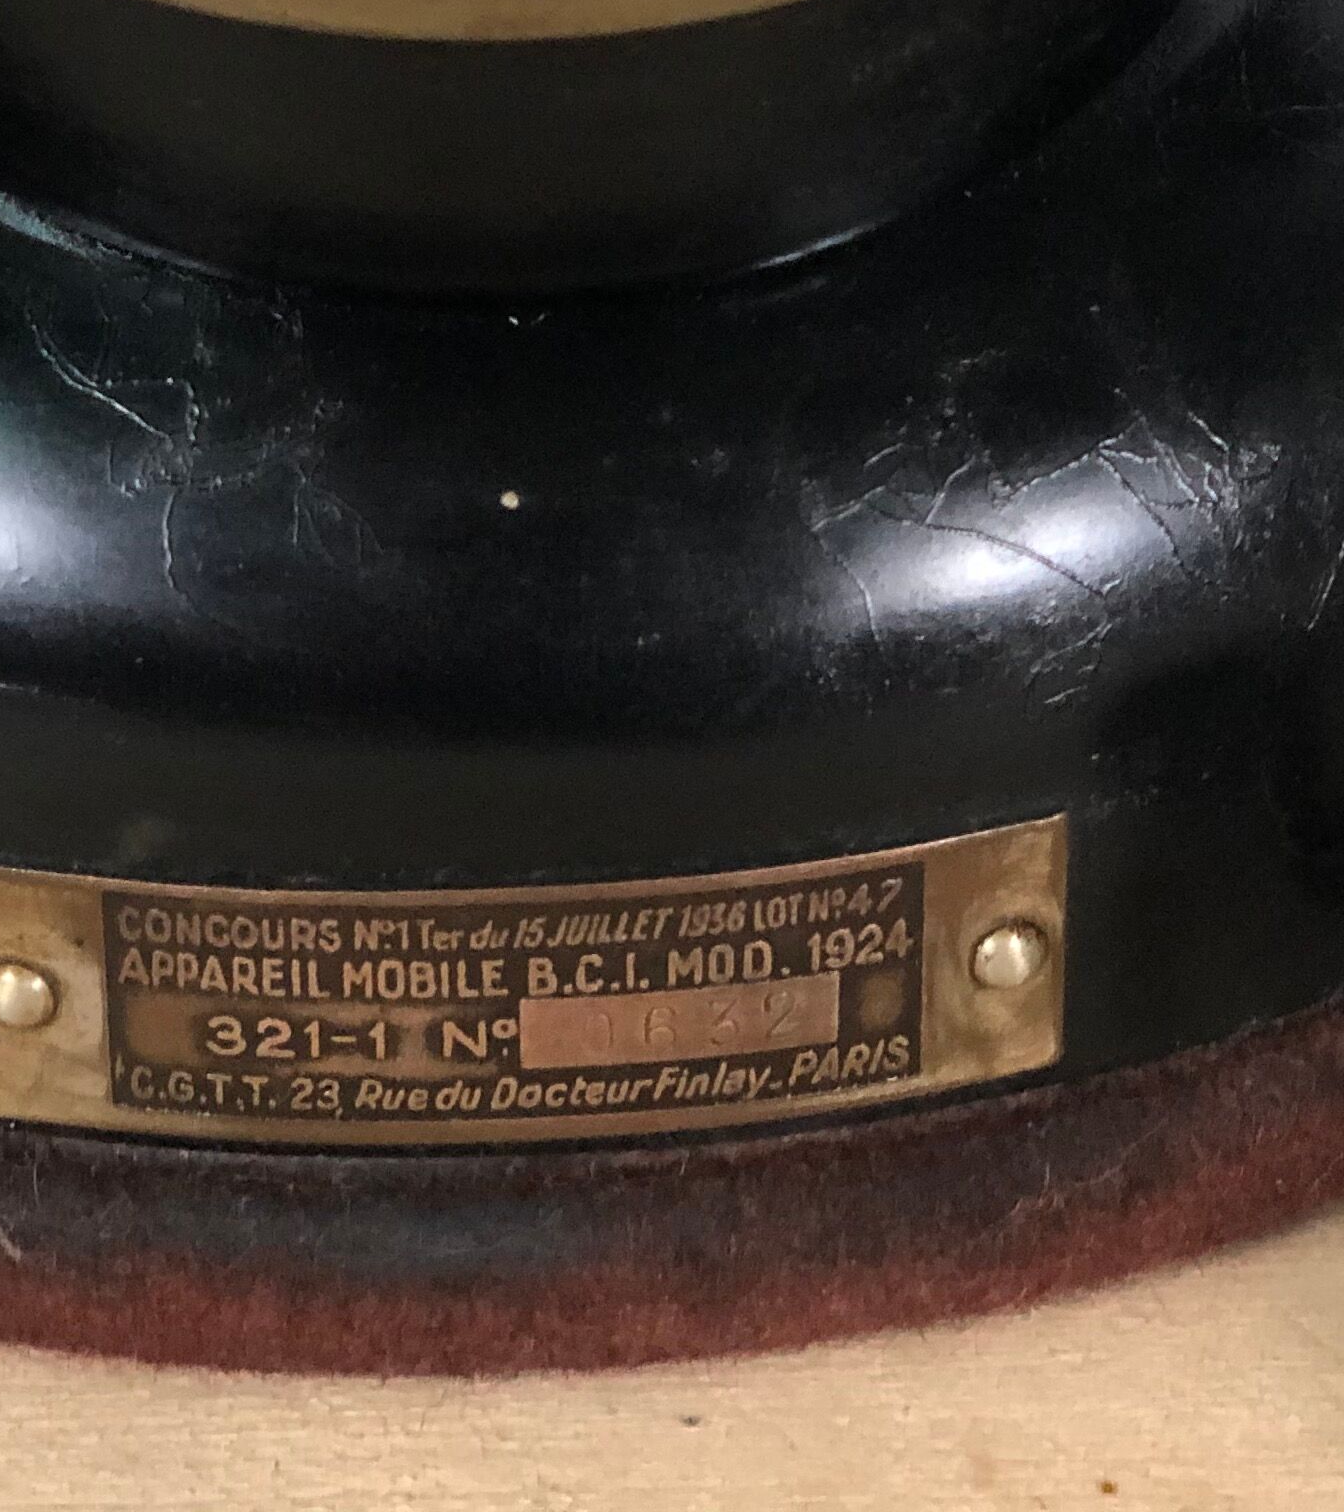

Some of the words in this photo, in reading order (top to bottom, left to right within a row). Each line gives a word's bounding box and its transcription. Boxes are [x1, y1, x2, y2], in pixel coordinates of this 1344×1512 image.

[117, 905, 343, 954] CONCOURS
[469, 920, 508, 951] du
[513, 916, 547, 949] 15
[546, 907, 674, 949] JUILLET
[753, 892, 804, 932] LOT
[117, 946, 332, 999] APPAREIL
[342, 959, 510, 1000] MOBILE
[807, 917, 914, 972] 1924
[355, 1078, 429, 1111] Rue
[434, 1080, 483, 1111] du
[490, 1076, 654, 1112] Docteur
